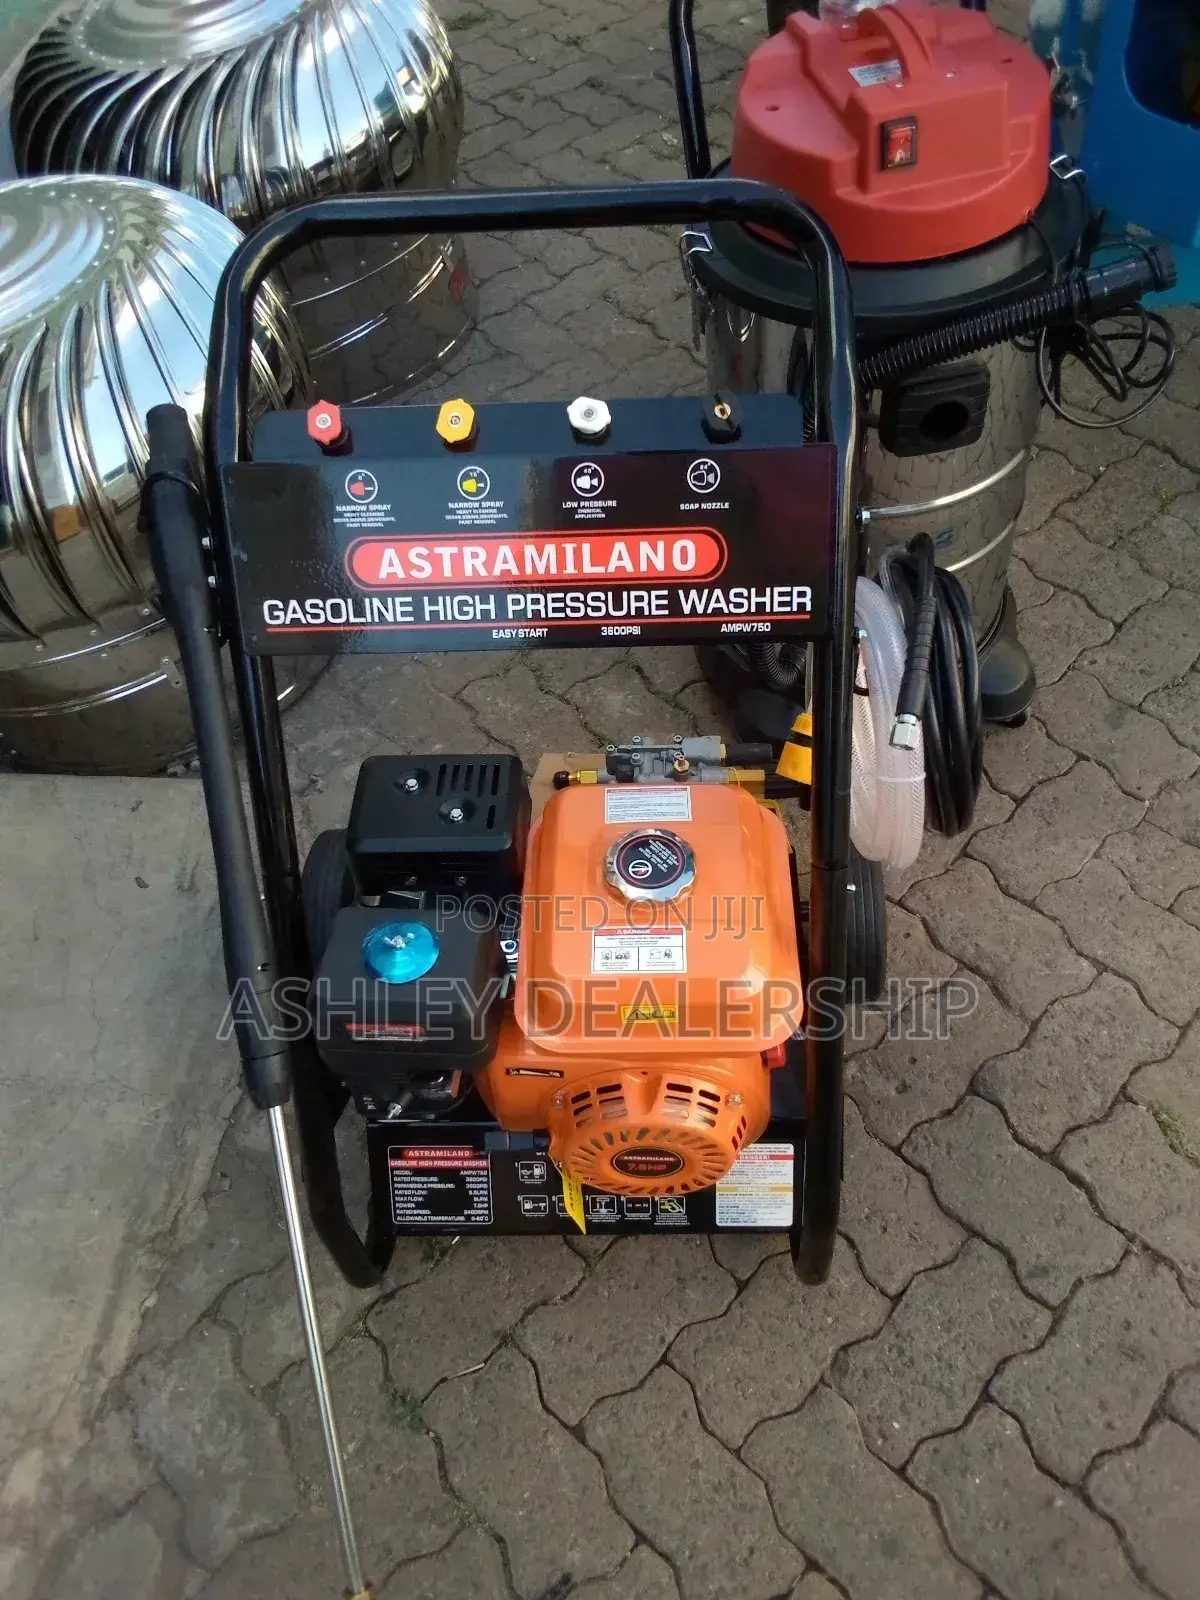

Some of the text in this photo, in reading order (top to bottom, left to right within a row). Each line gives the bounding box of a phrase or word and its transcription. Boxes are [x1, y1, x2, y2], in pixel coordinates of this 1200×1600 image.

[378, 538, 696, 580] ASTRAMILANO
[263, 586, 812, 624] GASOLINE HIGH PRESSURE WASHER
[492, 623, 770, 638] EASY START 3600PSI AMPW750
